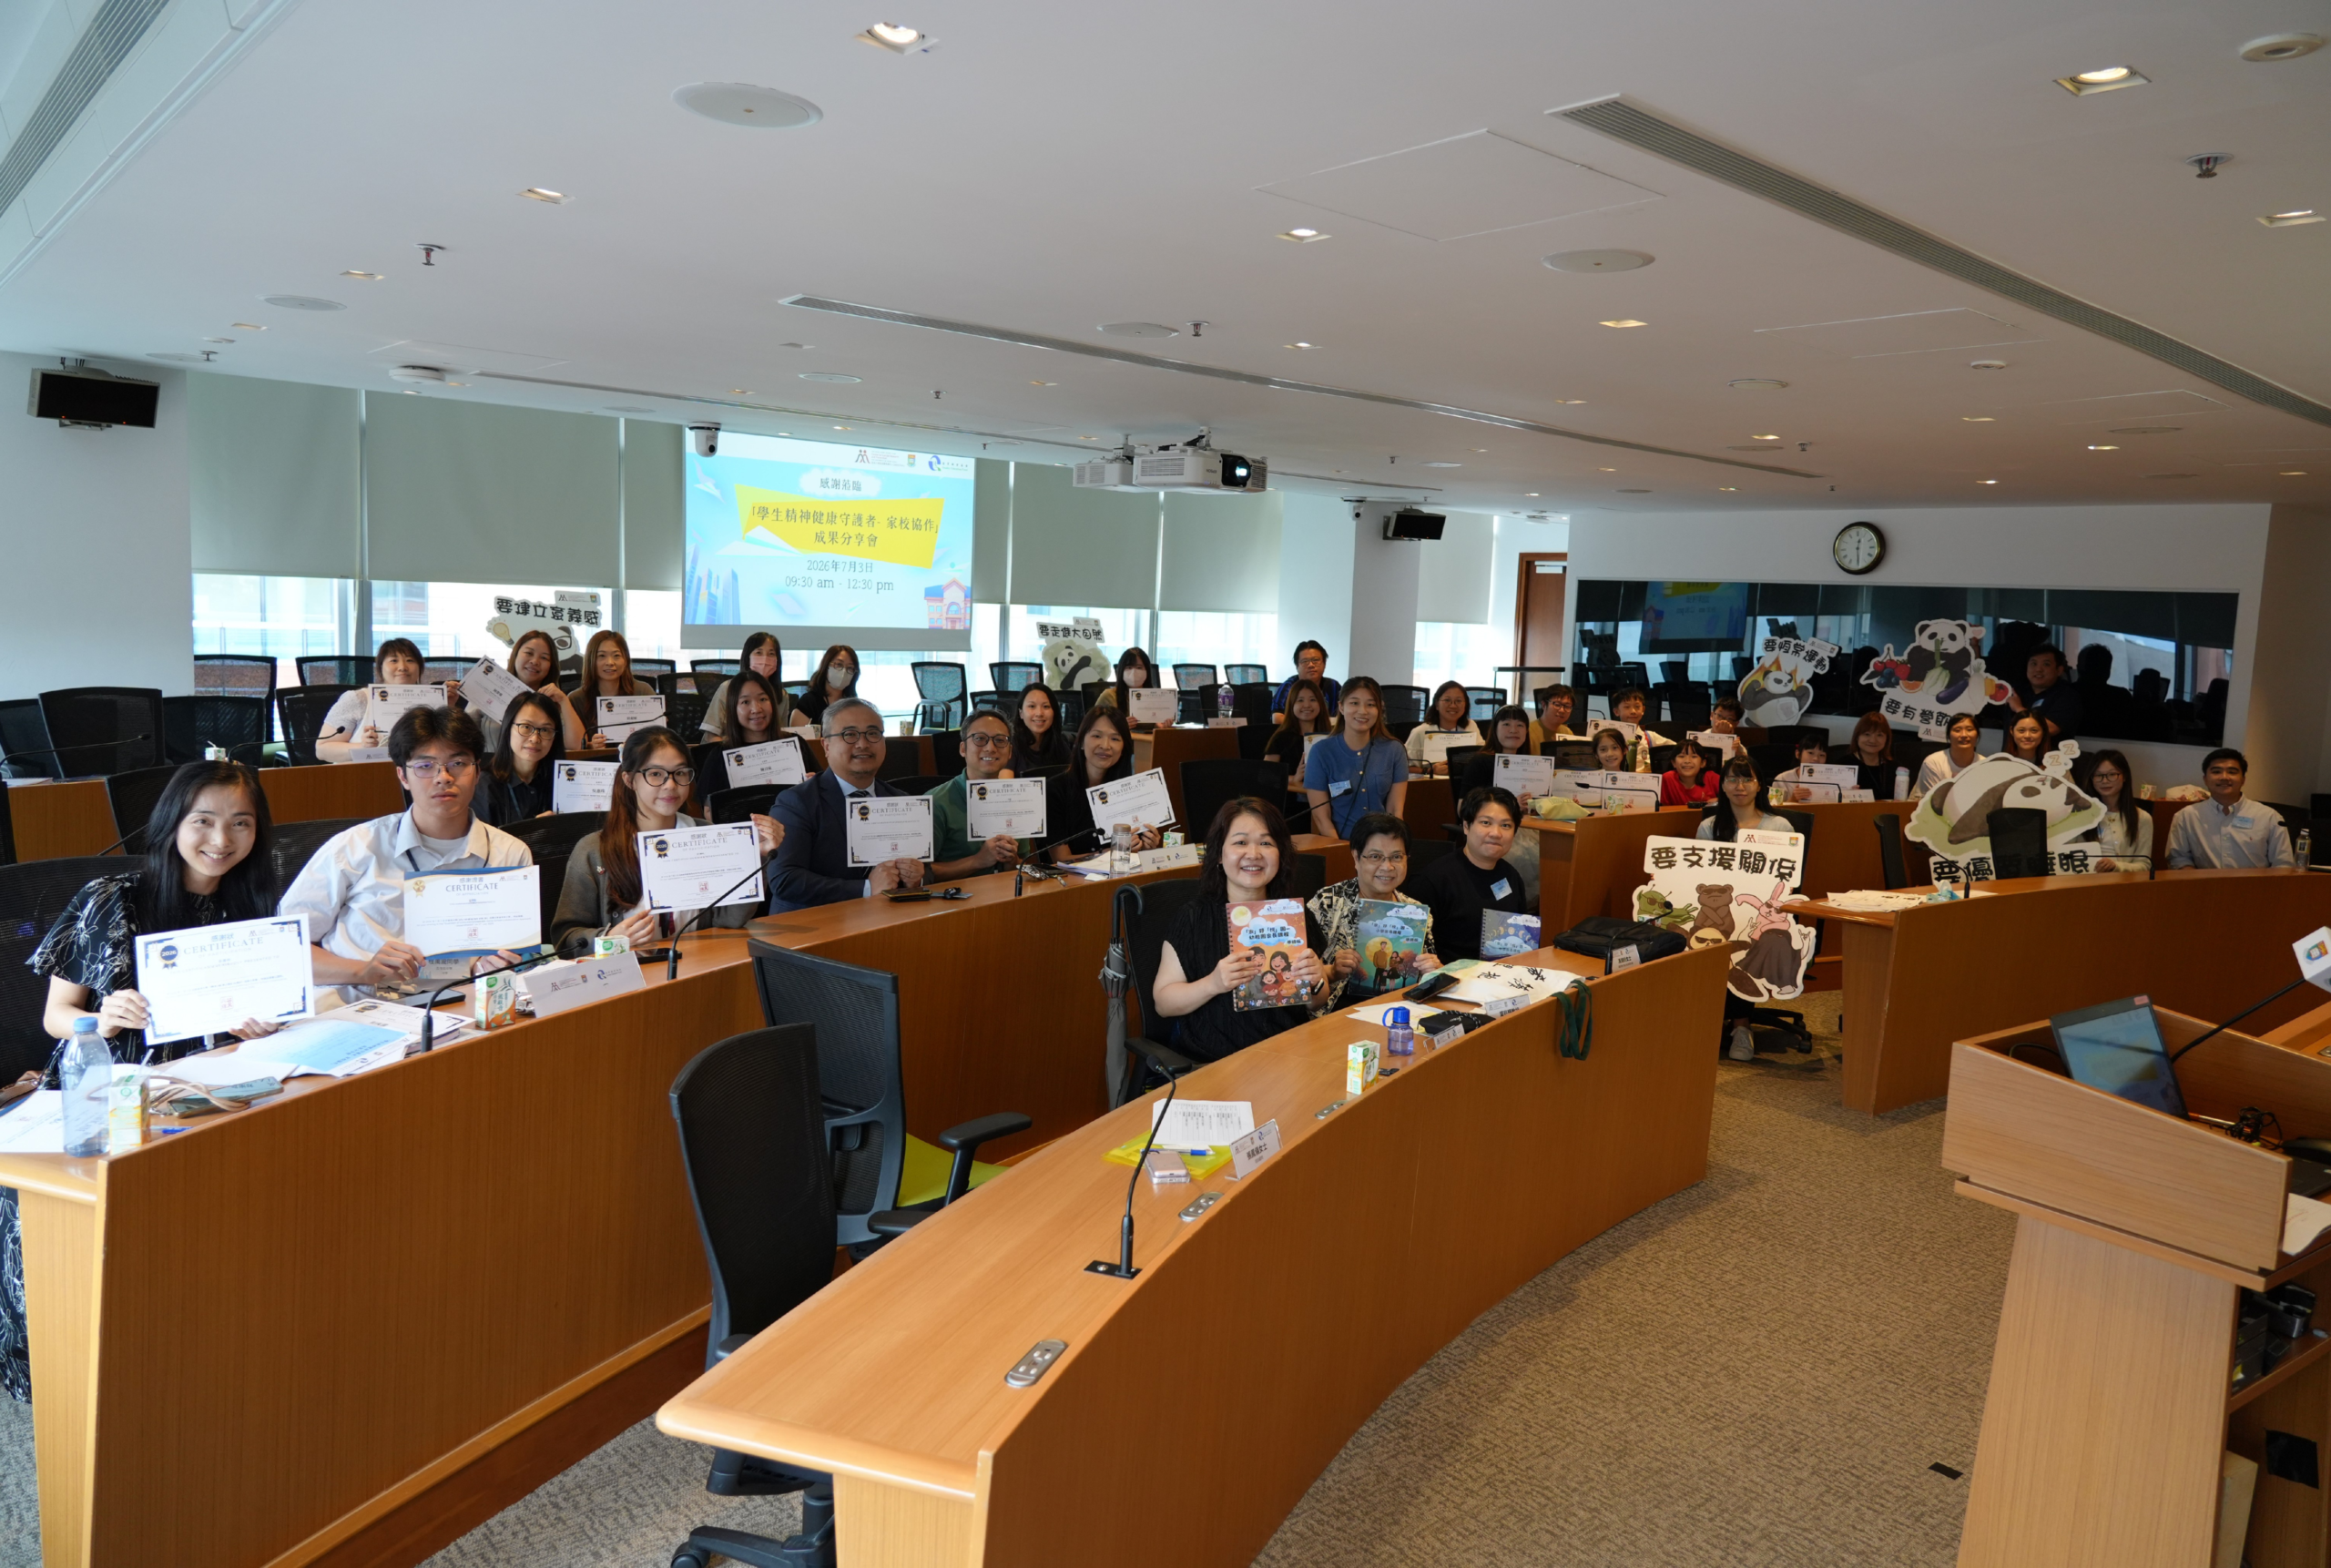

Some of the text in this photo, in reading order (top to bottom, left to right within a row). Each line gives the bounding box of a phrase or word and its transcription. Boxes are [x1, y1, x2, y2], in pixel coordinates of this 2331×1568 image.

[819, 477, 862, 492] 感謝蒞臨
[814, 531, 879, 547] 成果分享會
[807, 560, 874, 574] 2026年7月3日
[785, 576, 813, 588] 09:30
[817, 579, 835, 589] am
[848, 578, 873, 590] 12:30
[876, 581, 894, 594] pm
[496, 597, 599, 626] 要建立意義感
[1039, 624, 1103, 640] 要走進大自然
[1885, 697, 1951, 727] 要有營飲
[672, 838, 728, 849] CERTIFICATE
[1651, 845, 1797, 882] 要支援關係
[1933, 850, 2091, 884] 要優眠
[446, 882, 499, 892] CERTIFICATE
[183, 937, 264, 954] CERTIFICATE
